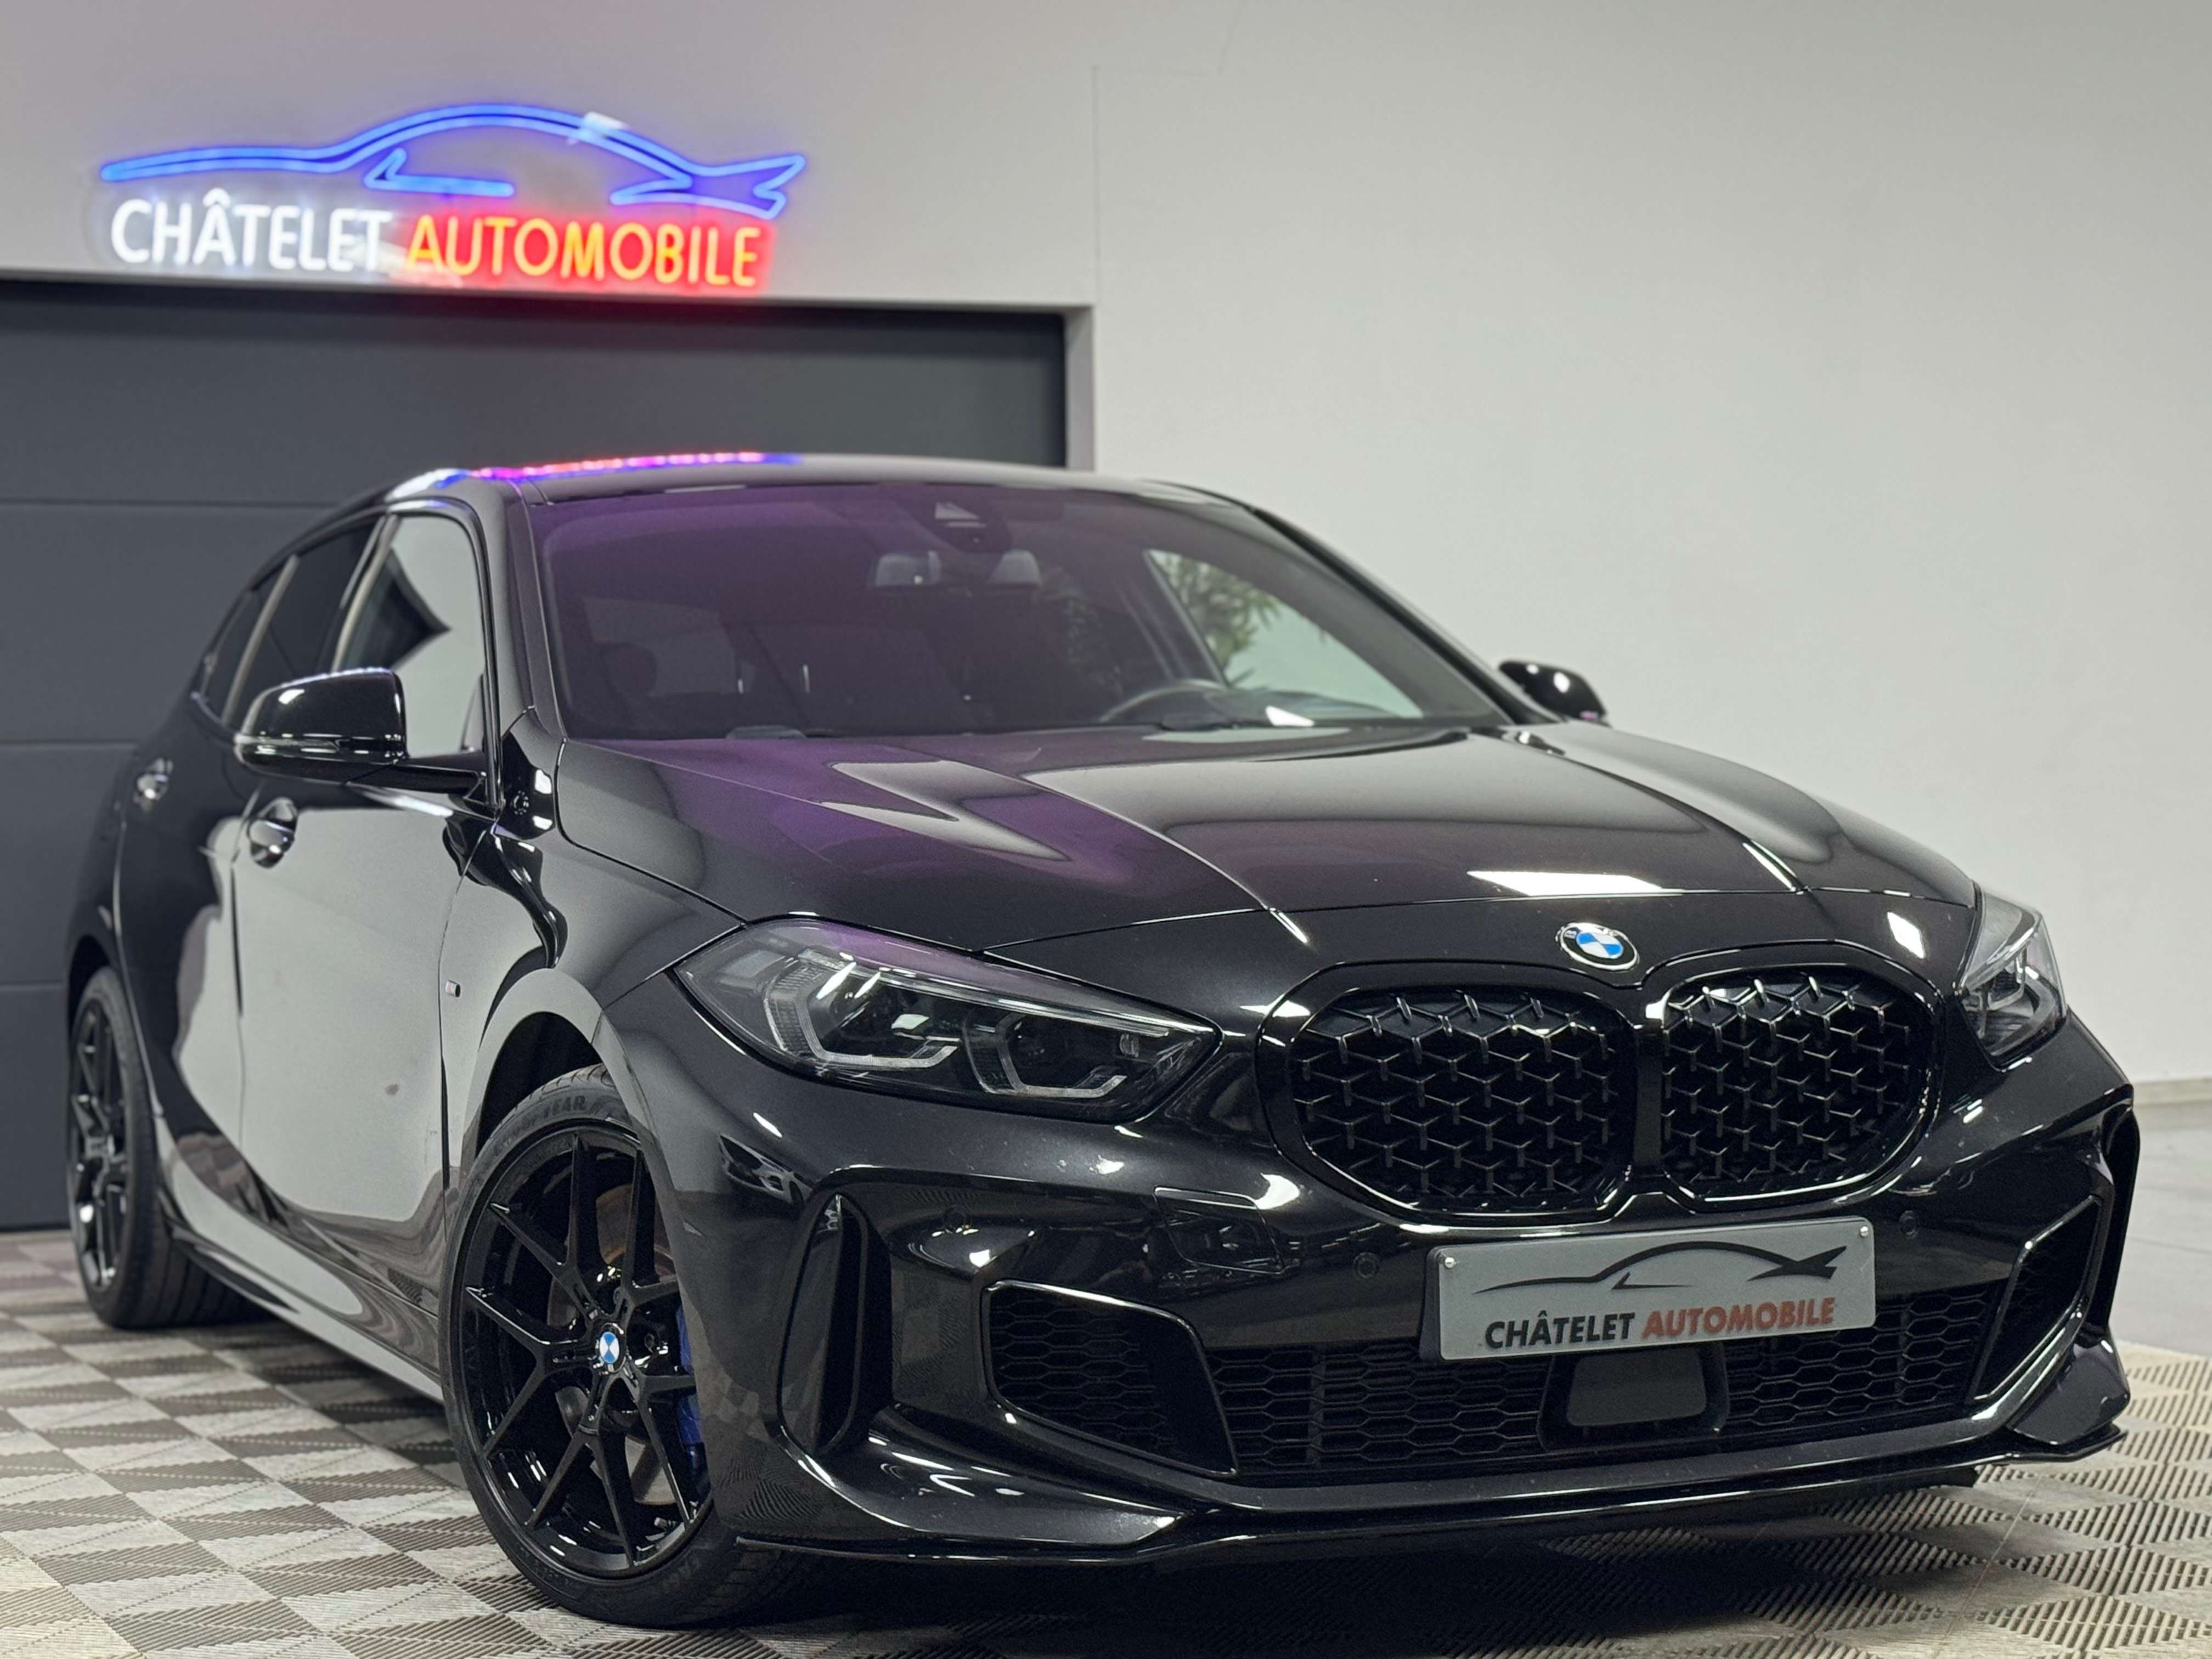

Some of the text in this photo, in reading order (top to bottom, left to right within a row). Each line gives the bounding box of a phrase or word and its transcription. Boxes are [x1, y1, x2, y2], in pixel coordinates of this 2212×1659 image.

[111, 188, 761, 287] CHÂTELET AUTOMOBILE
[1485, 1296, 1836, 1349] CHÂTELET AUTOMOBILE
